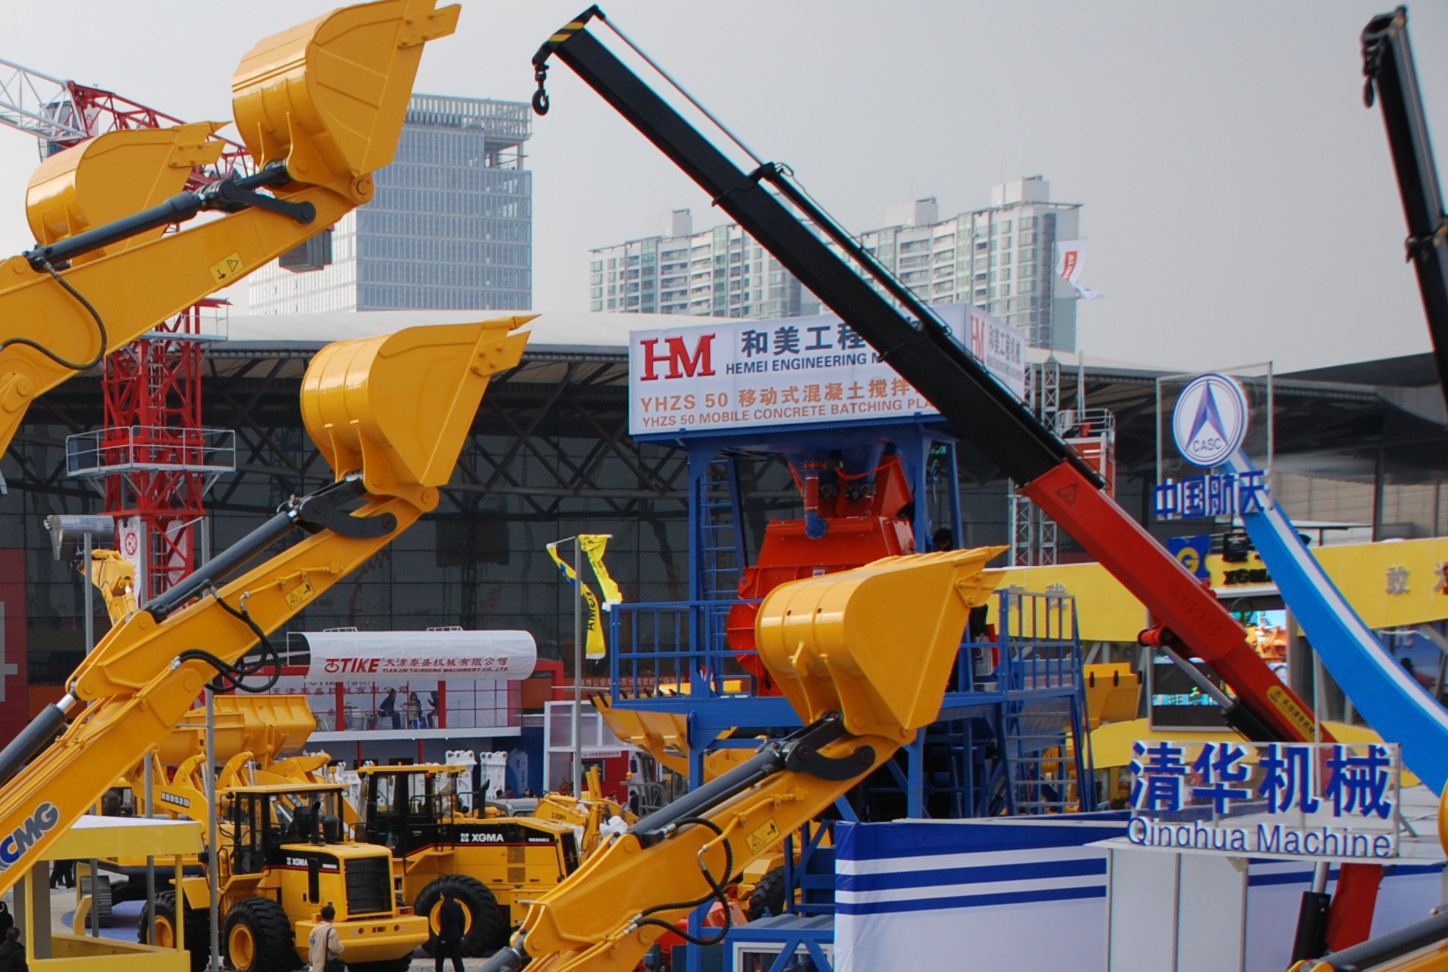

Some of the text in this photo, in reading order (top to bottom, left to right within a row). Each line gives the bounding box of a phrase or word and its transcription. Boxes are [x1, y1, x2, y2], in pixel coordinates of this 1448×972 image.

[640, 333, 716, 381] HM
[726, 361, 768, 375] HEMEI
[772, 353, 867, 372] ENGINEERING
[641, 377, 921, 413] YHZS 50 移动式混凝土搅拌
[642, 397, 935, 428] YHZS 50 MOBILE CONCRETE BATCHING PLA
[1193, 438, 1222, 452] CASC
[1154, 470, 1267, 520] 中国航天
[1128, 741, 1394, 820] 清华机械
[472, 833, 504, 842] XGMA
[1127, 816, 1393, 857] Qinghua Machine
